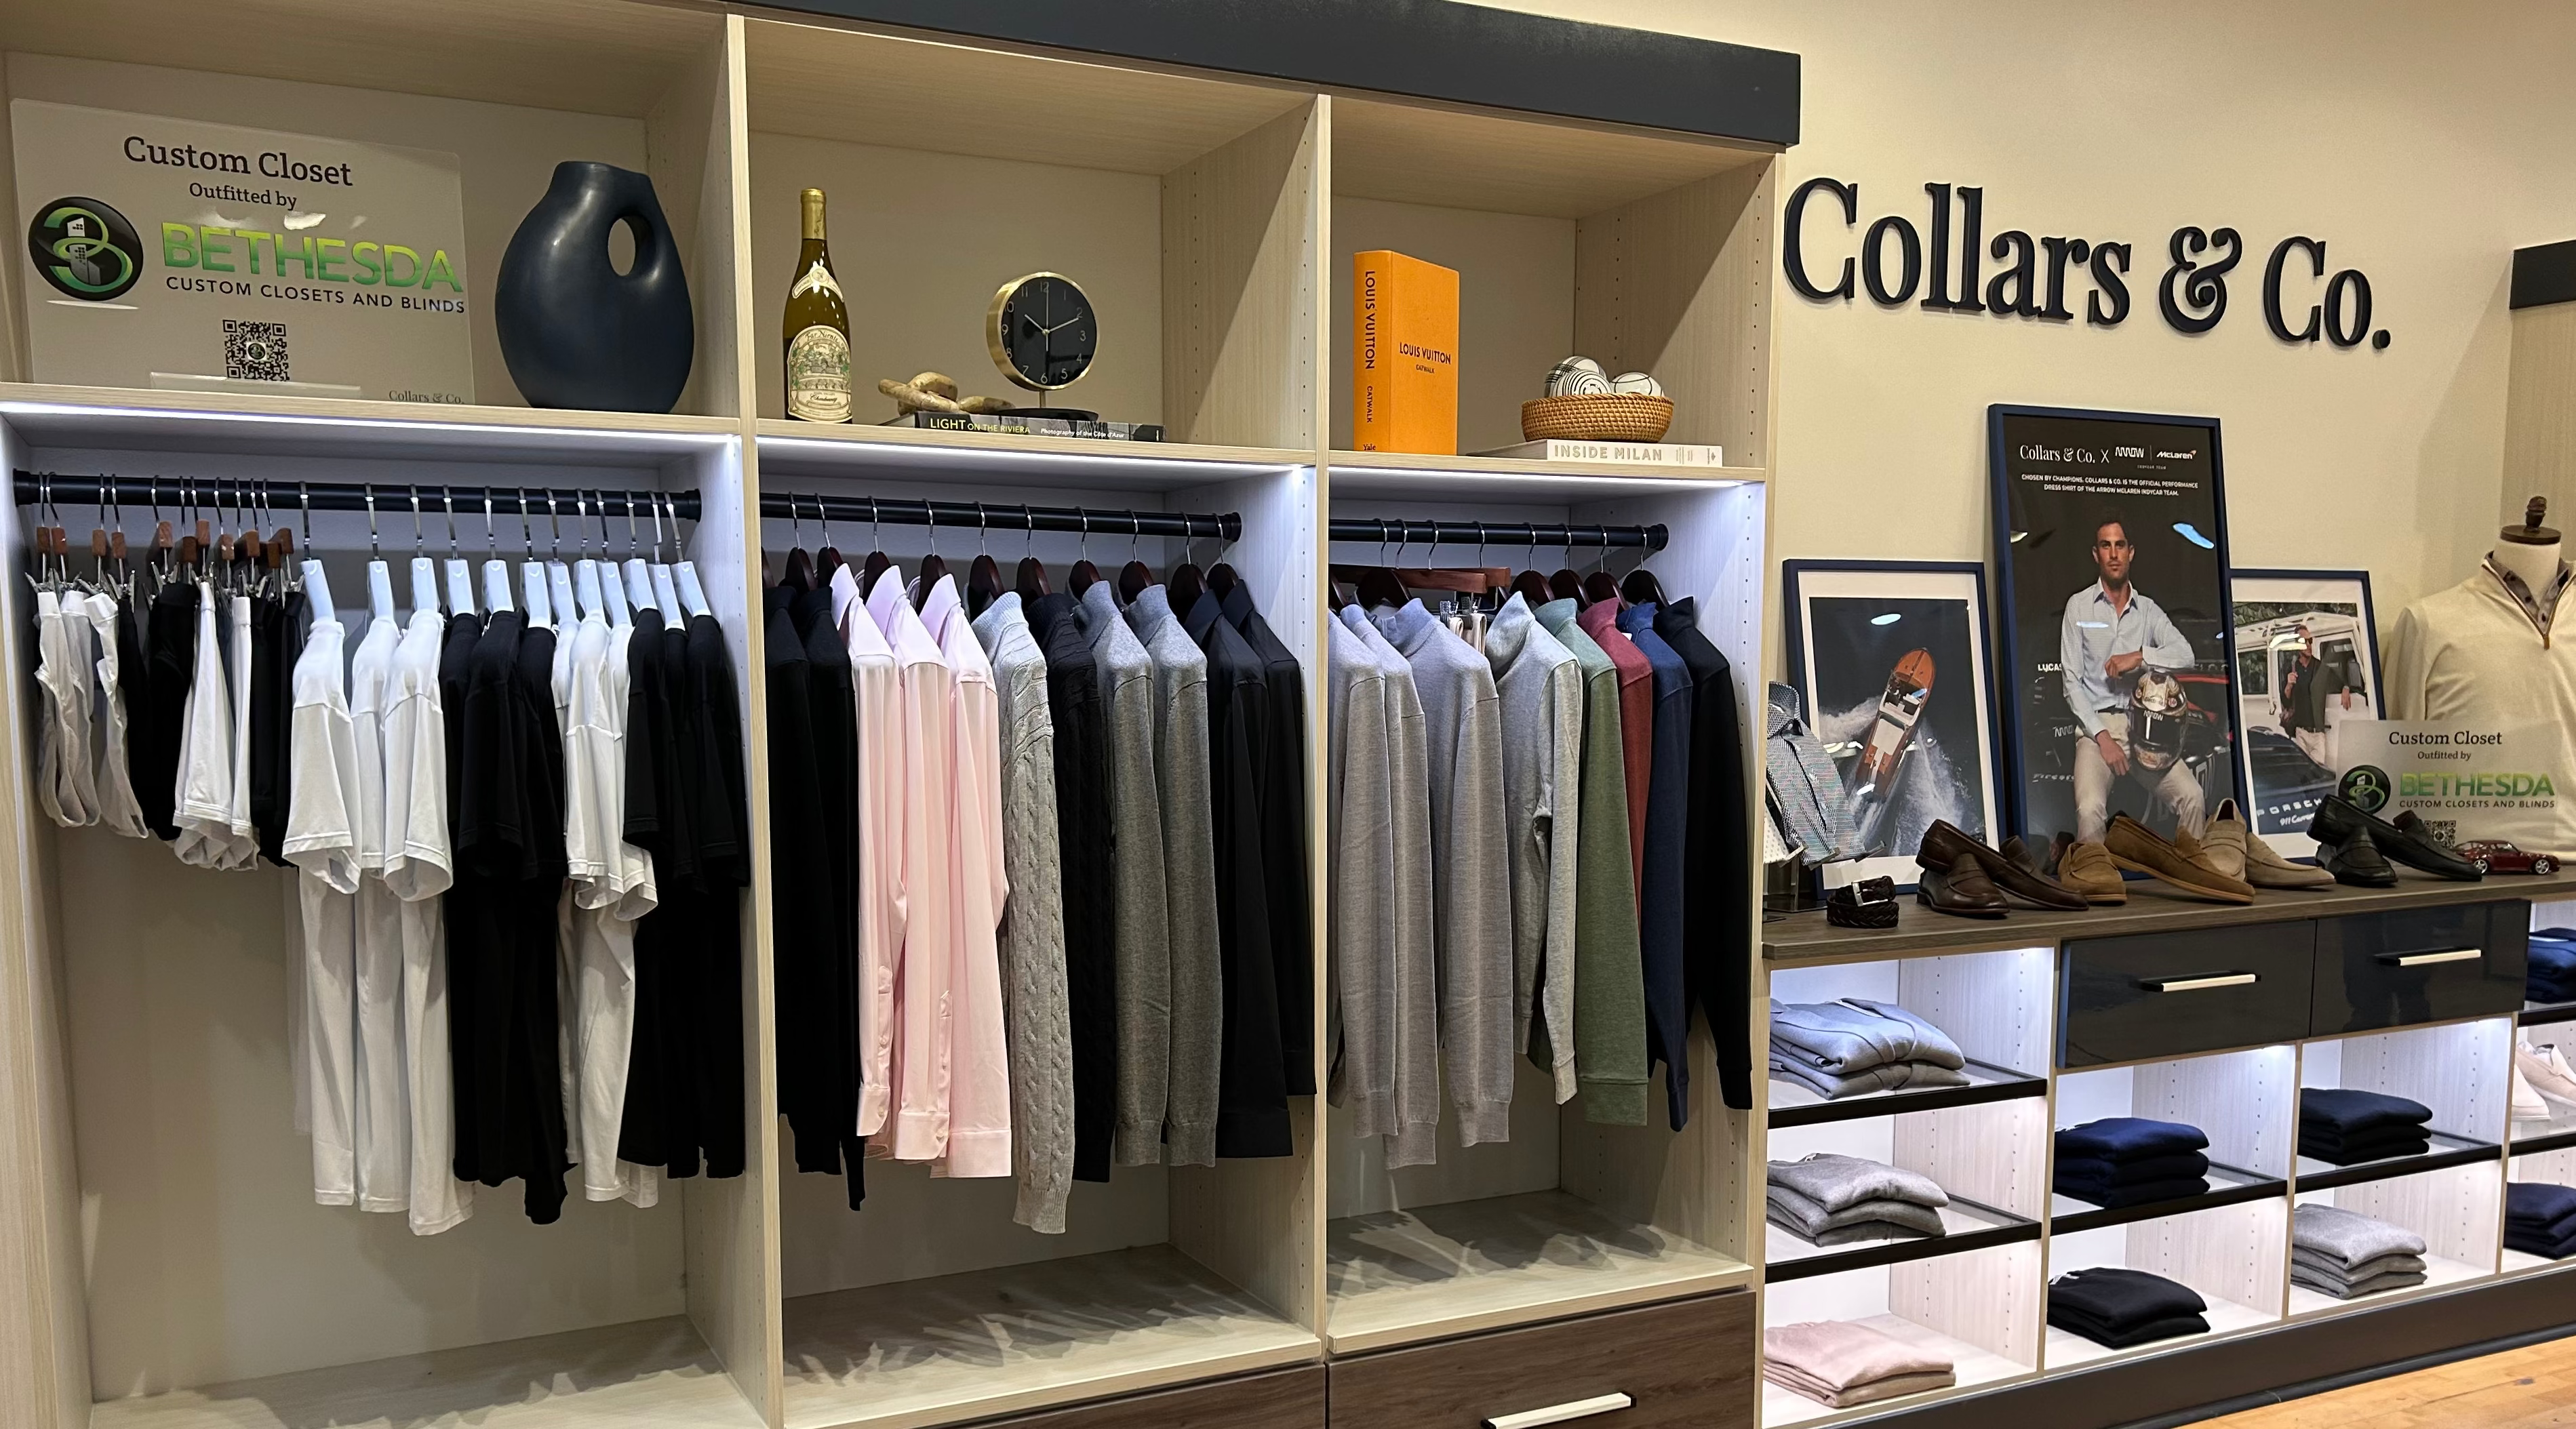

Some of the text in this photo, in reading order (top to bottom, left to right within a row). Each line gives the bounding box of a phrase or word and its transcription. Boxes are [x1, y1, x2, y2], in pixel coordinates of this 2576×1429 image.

[123, 136, 353, 186] Custom Closet
[189, 182, 297, 211] Outfitted by
[161, 221, 464, 292] BETHESDA
[1783, 176, 2392, 350] Collars & Co.
[1021, 286, 1028, 298] 11
[1040, 281, 1049, 292] 12
[165, 276, 466, 314] CUSTOM CLOSETS AND BLINDS
[1076, 307, 1083, 318] 2
[1365, 270, 1376, 369] LOUIS VUITTON
[1002, 324, 1008, 336] 9
[1079, 330, 1086, 342] 3
[1006, 347, 1012, 359] 8
[1076, 353, 1082, 364] 4
[1400, 342, 1451, 365] LOUIS VUITTON
[1023, 365, 1029, 376] 7
[1061, 368, 1068, 380] 5
[1416, 364, 1435, 374] CATWALK
[1040, 372, 1048, 384] 6
[389, 390, 464, 404] Collars & Co.
[930, 418, 1030, 434] LIGHT ON THE RIVIERA
[1040, 428, 1075, 437] Photography
[1554, 444, 1608, 459] INSIDE
[1614, 447, 1663, 461] MILAN
[2020, 445, 2061, 462] Collars
[2063, 447, 2074, 462] &
[2076, 448, 2095, 463] Co.
[2101, 449, 2109, 464] X
[2156, 450, 2194, 460] McLaren
[2162, 481, 2198, 489] PERFORMANCE
[2388, 730, 2503, 745] Custom Closet
[2417, 750, 2472, 761] Outfitted by
[2399, 772, 2555, 797] BETHESDA
[2257, 798, 2322, 817] PORSCH
[2399, 800, 2555, 808] CUSTOM CLOSETS AND BLINDS
